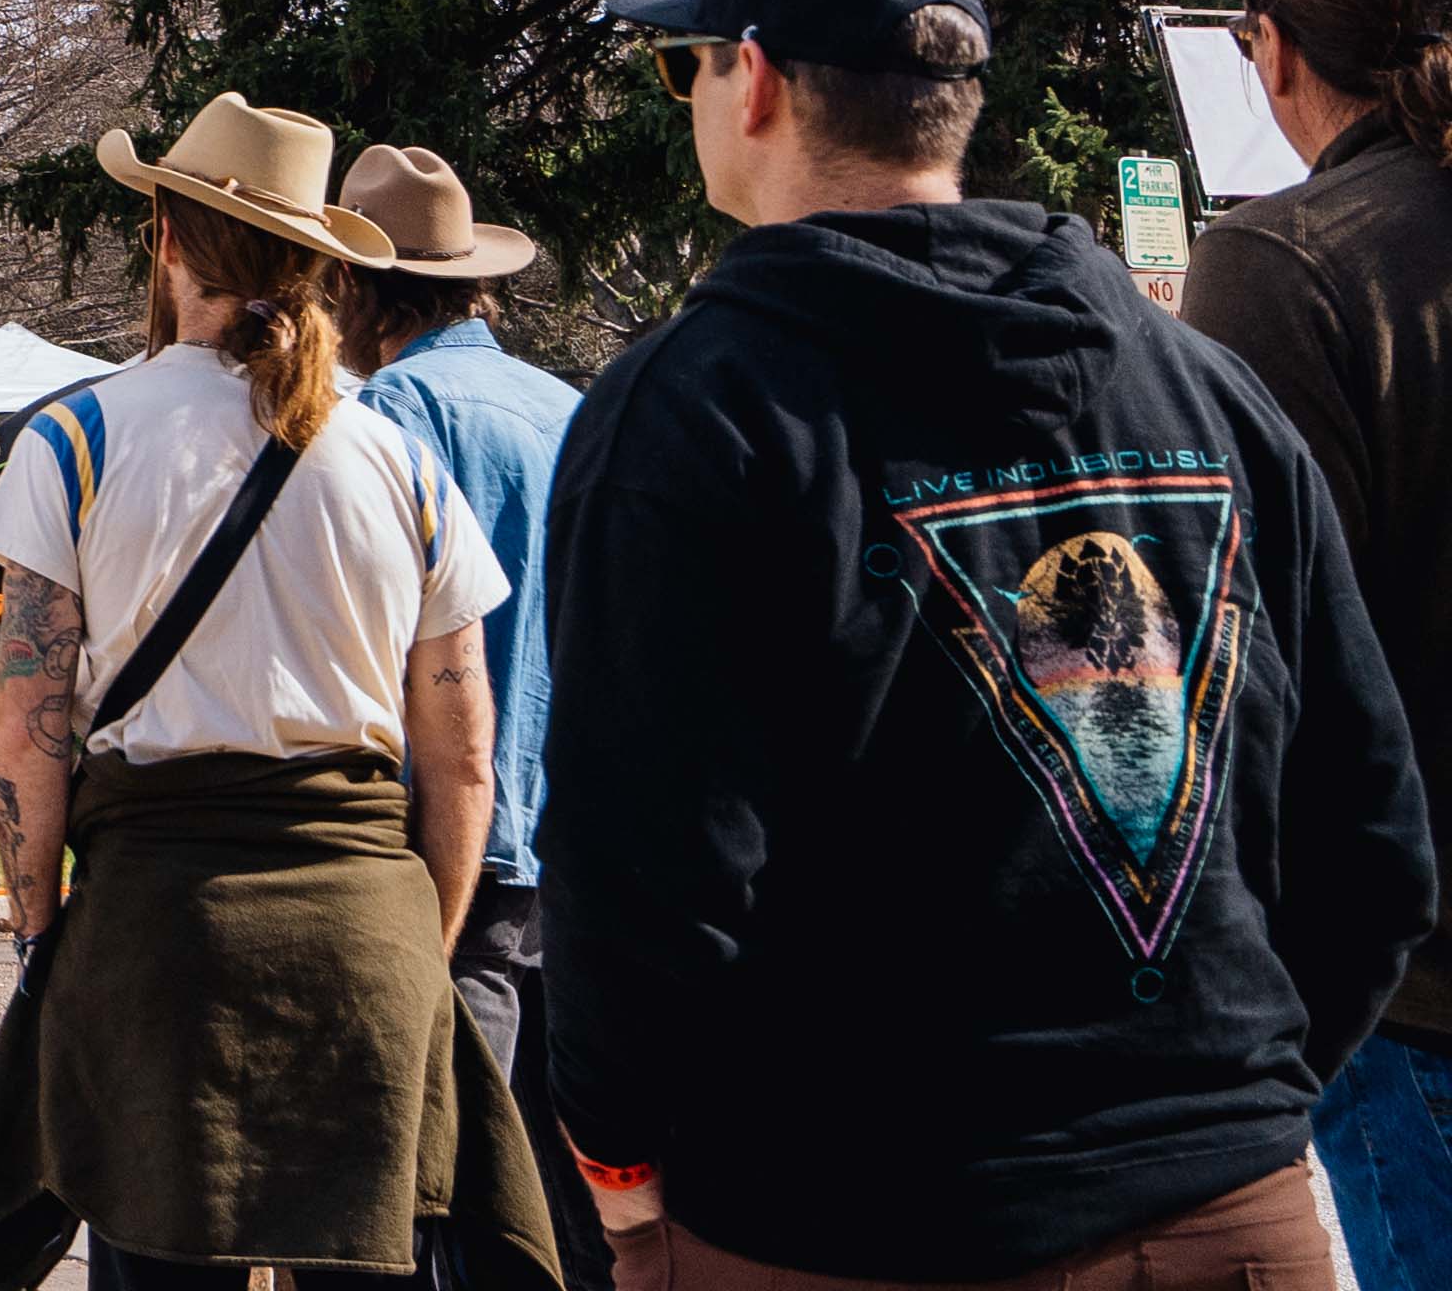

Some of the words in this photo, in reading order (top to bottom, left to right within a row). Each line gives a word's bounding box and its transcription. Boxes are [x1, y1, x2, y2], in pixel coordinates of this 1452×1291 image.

[1124, 166, 1137, 190] 2
[1140, 181, 1175, 195] PARKING
[1148, 282, 1174, 302] NO
[883, 471, 975, 505] LIVE
